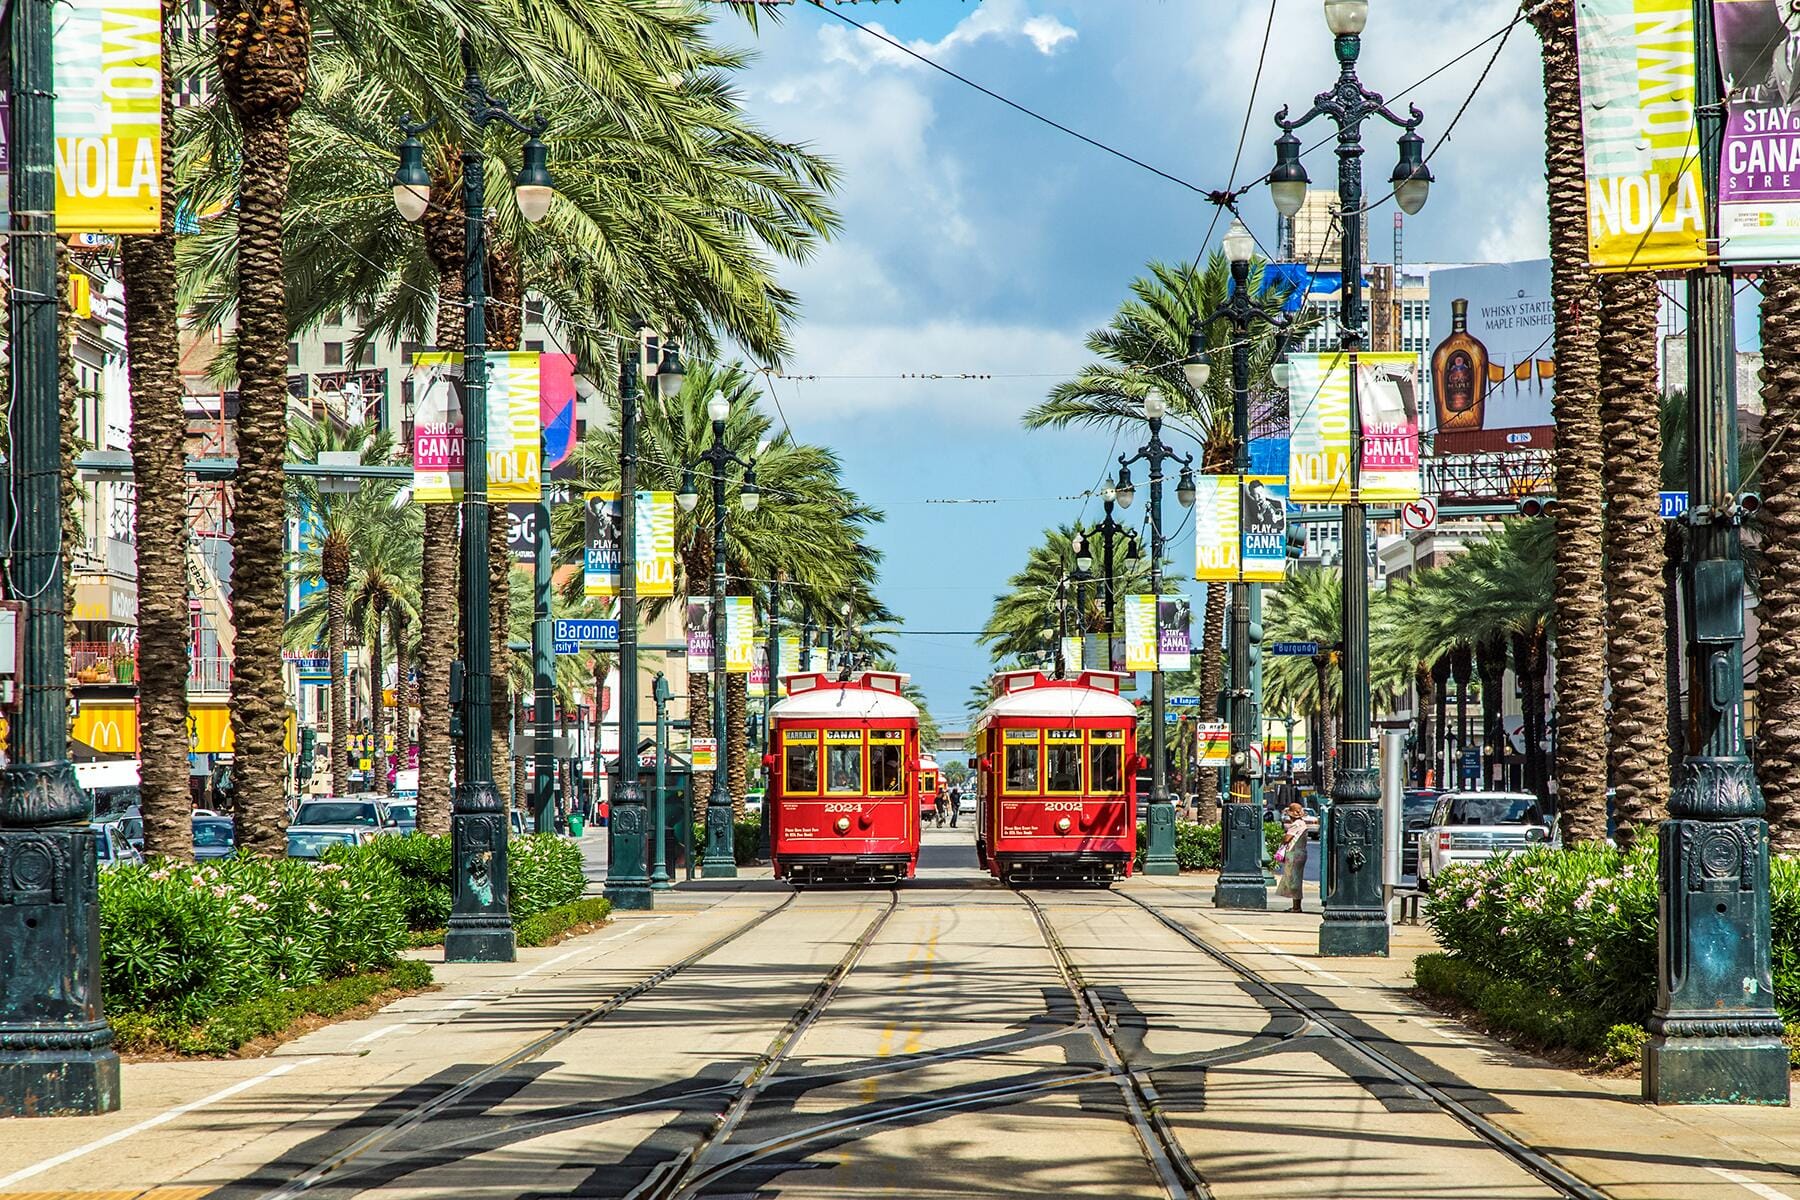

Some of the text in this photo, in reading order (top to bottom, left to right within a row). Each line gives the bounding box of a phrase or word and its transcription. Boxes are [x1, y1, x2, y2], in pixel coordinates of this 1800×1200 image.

[101, 0, 160, 134] TOW
[1634, 10, 1700, 171] TOWN
[1744, 107, 1792, 132] STAY
[56, 137, 158, 197] NOLA
[1729, 175, 1791, 189] STRE
[1590, 173, 1704, 237] NOLA
[1481, 304, 1518, 318] WHISKY
[1485, 313, 1555, 330] MAPLE FINISHED
[424, 422, 455, 435] SHOP
[1369, 422, 1397, 435] SHOP
[418, 438, 465, 457] CANA
[1364, 436, 1414, 458] CANAL
[1364, 455, 1415, 464] STREET
[487, 451, 539, 483] NOLA
[1290, 452, 1349, 485] NOLA
[1660, 494, 1689, 516] phi
[1251, 524, 1271, 534] PLAY
[593, 539, 613, 549] PLAY
[1246, 535, 1283, 549] CANAL
[588, 550, 621, 564] CANA
[1197, 545, 1238, 569] NOLA
[558, 621, 617, 639] Baronne
[1165, 629, 1179, 637] STAY
[1161, 636, 1188, 648] CANAL
[1278, 643, 1316, 654] Burgundy
[282, 650, 330, 659] HOLLWOOD
[1126, 642, 1156, 663] NOLA
[826, 731, 861, 739] CANAL
[1051, 730, 1078, 738] RTA
[824, 802, 863, 813] 2024
[1044, 801, 1083, 811] 2002
